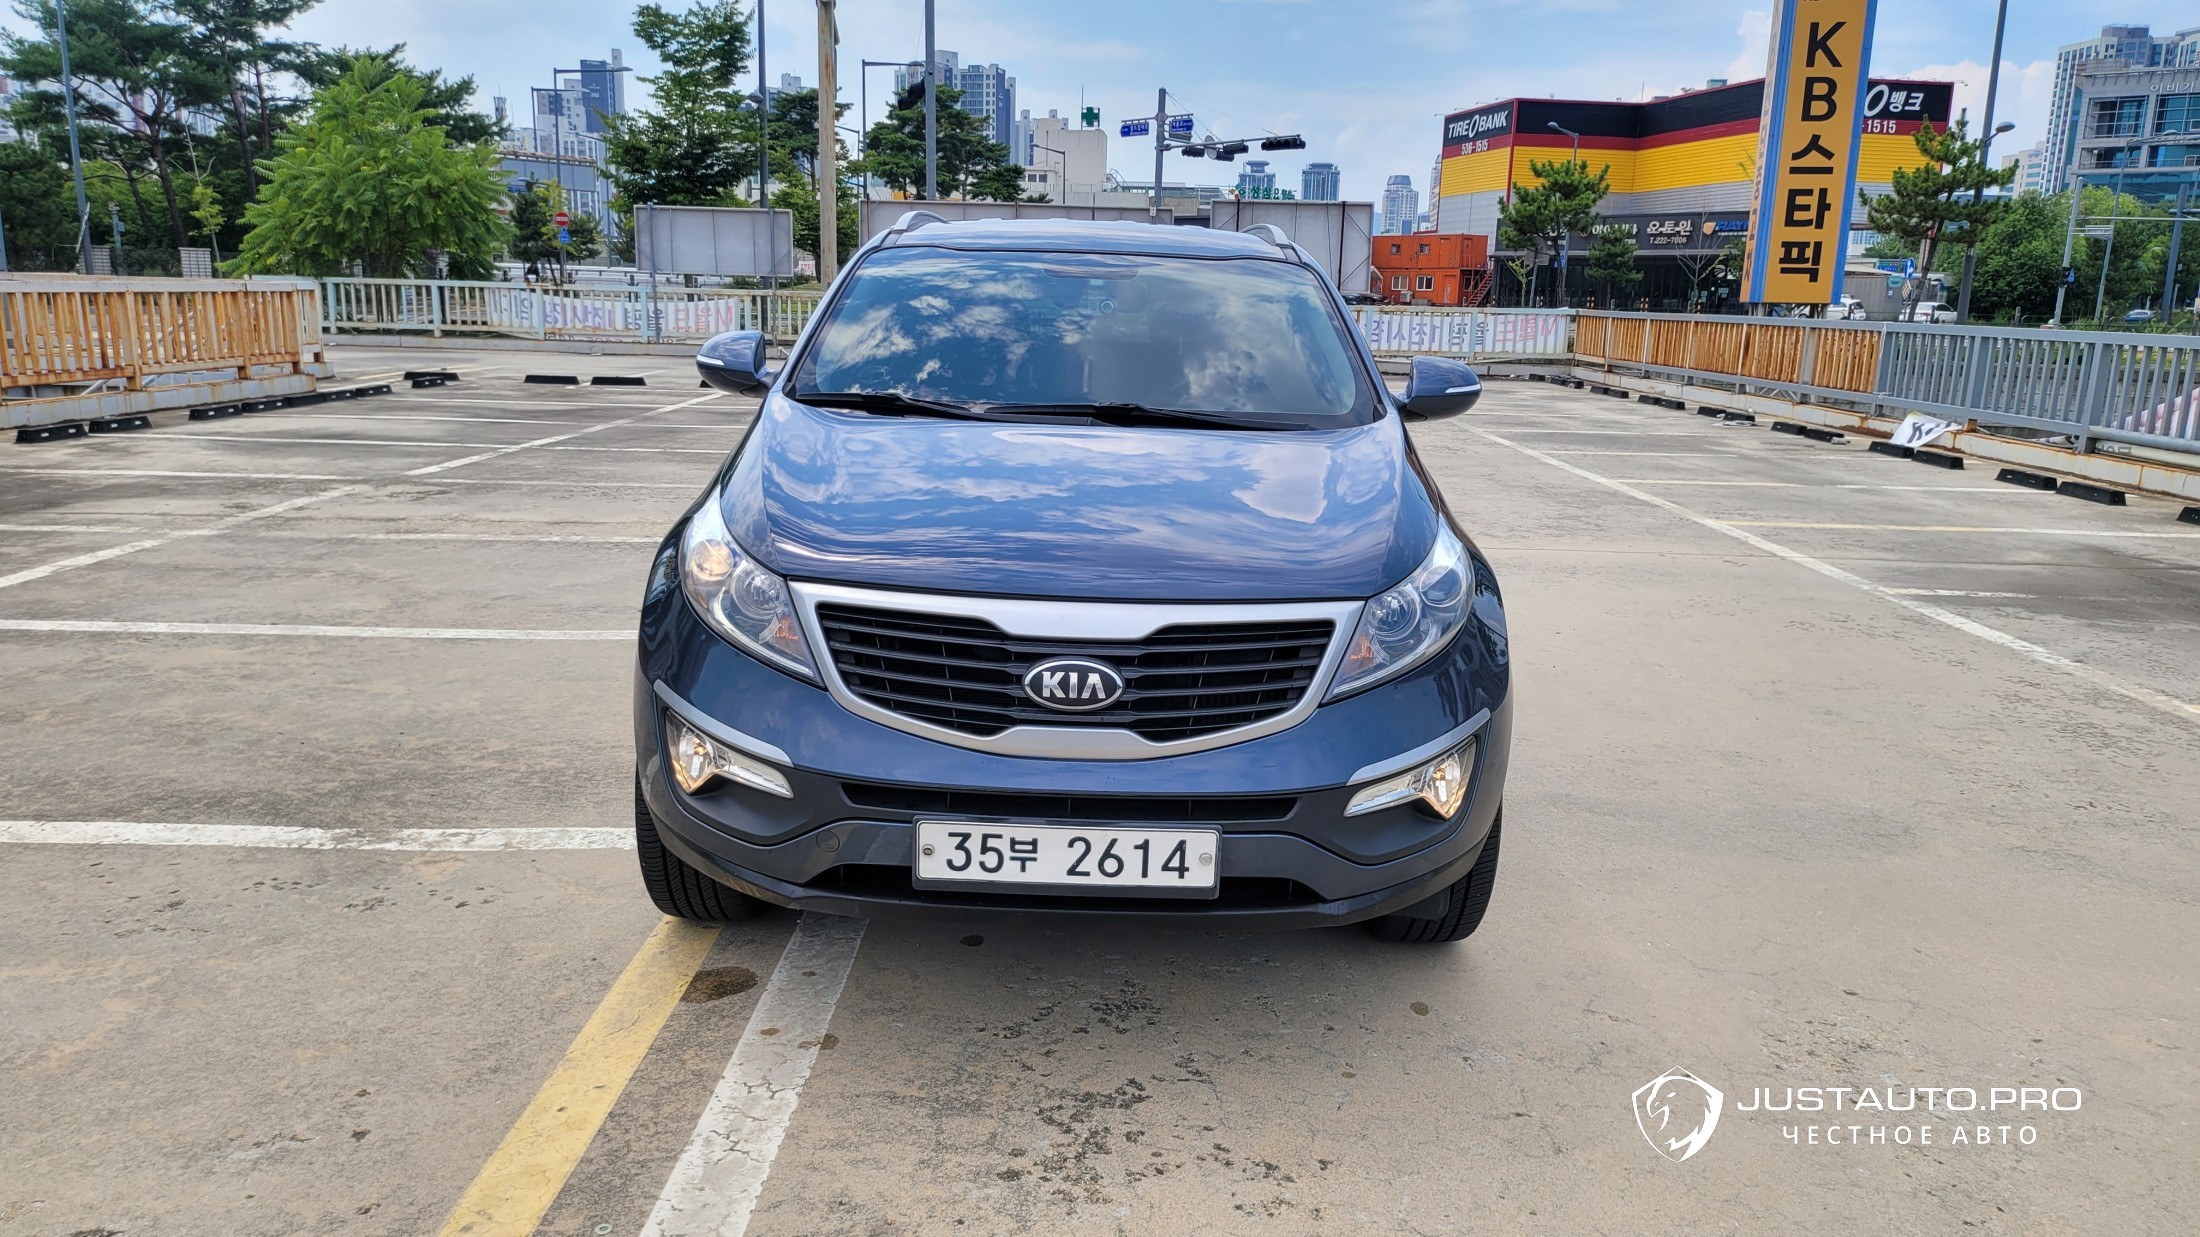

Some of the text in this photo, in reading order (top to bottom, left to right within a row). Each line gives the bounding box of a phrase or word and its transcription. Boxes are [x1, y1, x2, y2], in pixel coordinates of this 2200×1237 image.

[1778, 21, 1848, 284] KB스타픽
[1042, 671, 1106, 699] KIA
[946, 832, 1190, 879] 35부 2614
